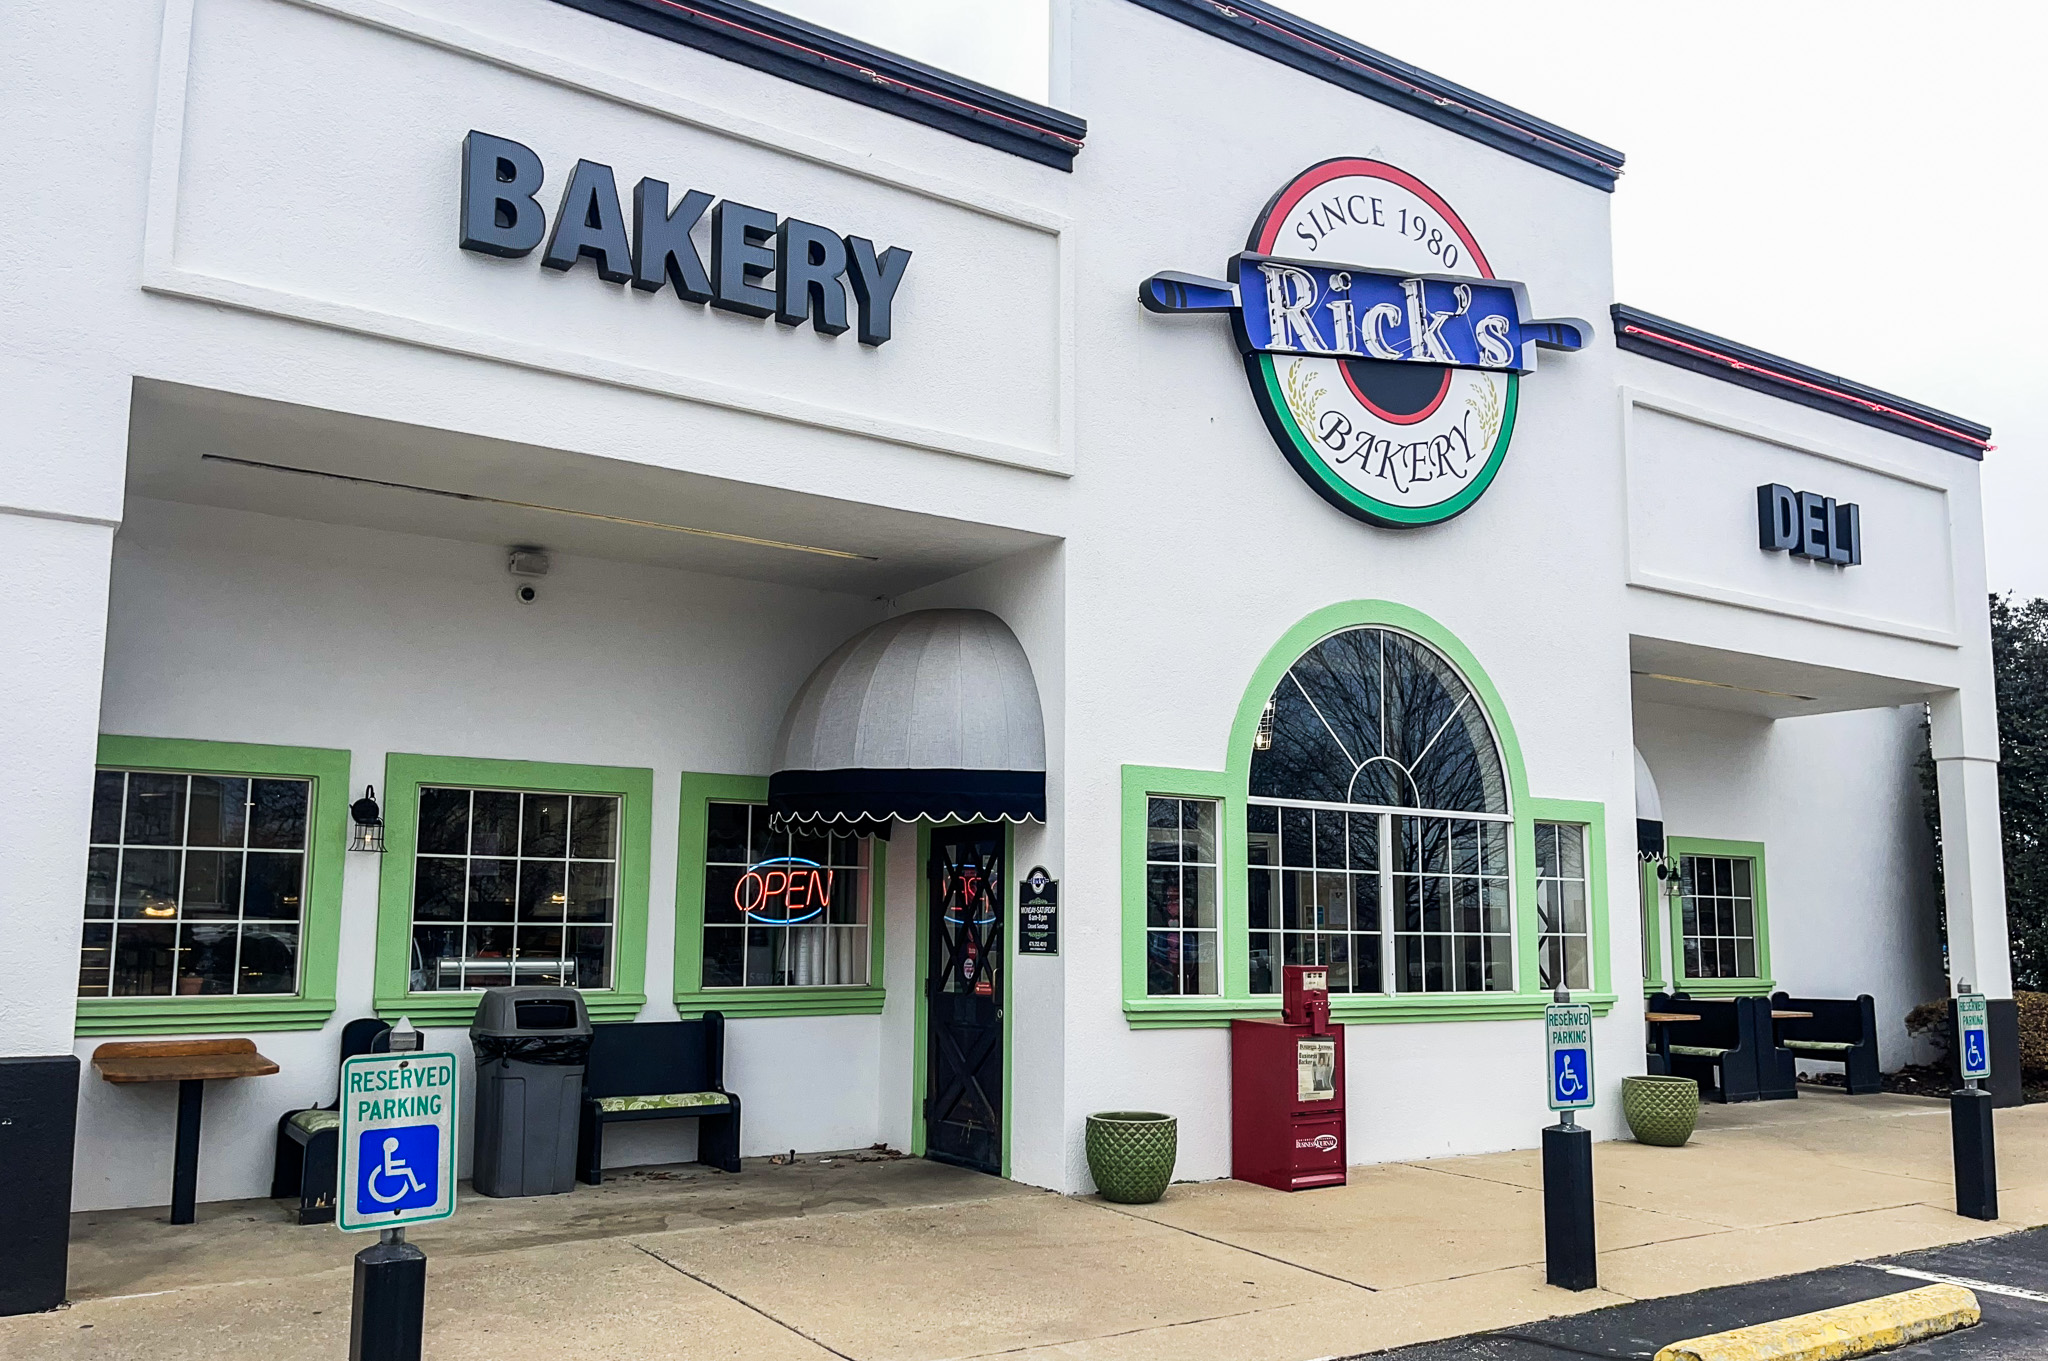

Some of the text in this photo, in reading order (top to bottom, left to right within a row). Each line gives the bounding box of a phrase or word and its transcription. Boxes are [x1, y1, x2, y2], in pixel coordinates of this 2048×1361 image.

[459, 129, 912, 347] BAKERY
[1296, 194, 1459, 269] SINCE 1980
[1257, 261, 1515, 368] Rick's
[1318, 409, 1477, 494] BAKERY
[1757, 482, 1861, 567] DELI
[734, 869, 834, 911] OPEN
[1549, 1013, 1589, 1026] RESERVED
[1959, 1001, 1984, 1011] RESERVED
[1963, 1014, 1984, 1025] PARKING
[1553, 1030, 1587, 1044] PARKING
[351, 1065, 451, 1093] RESERVED
[358, 1094, 442, 1122] PARKING
